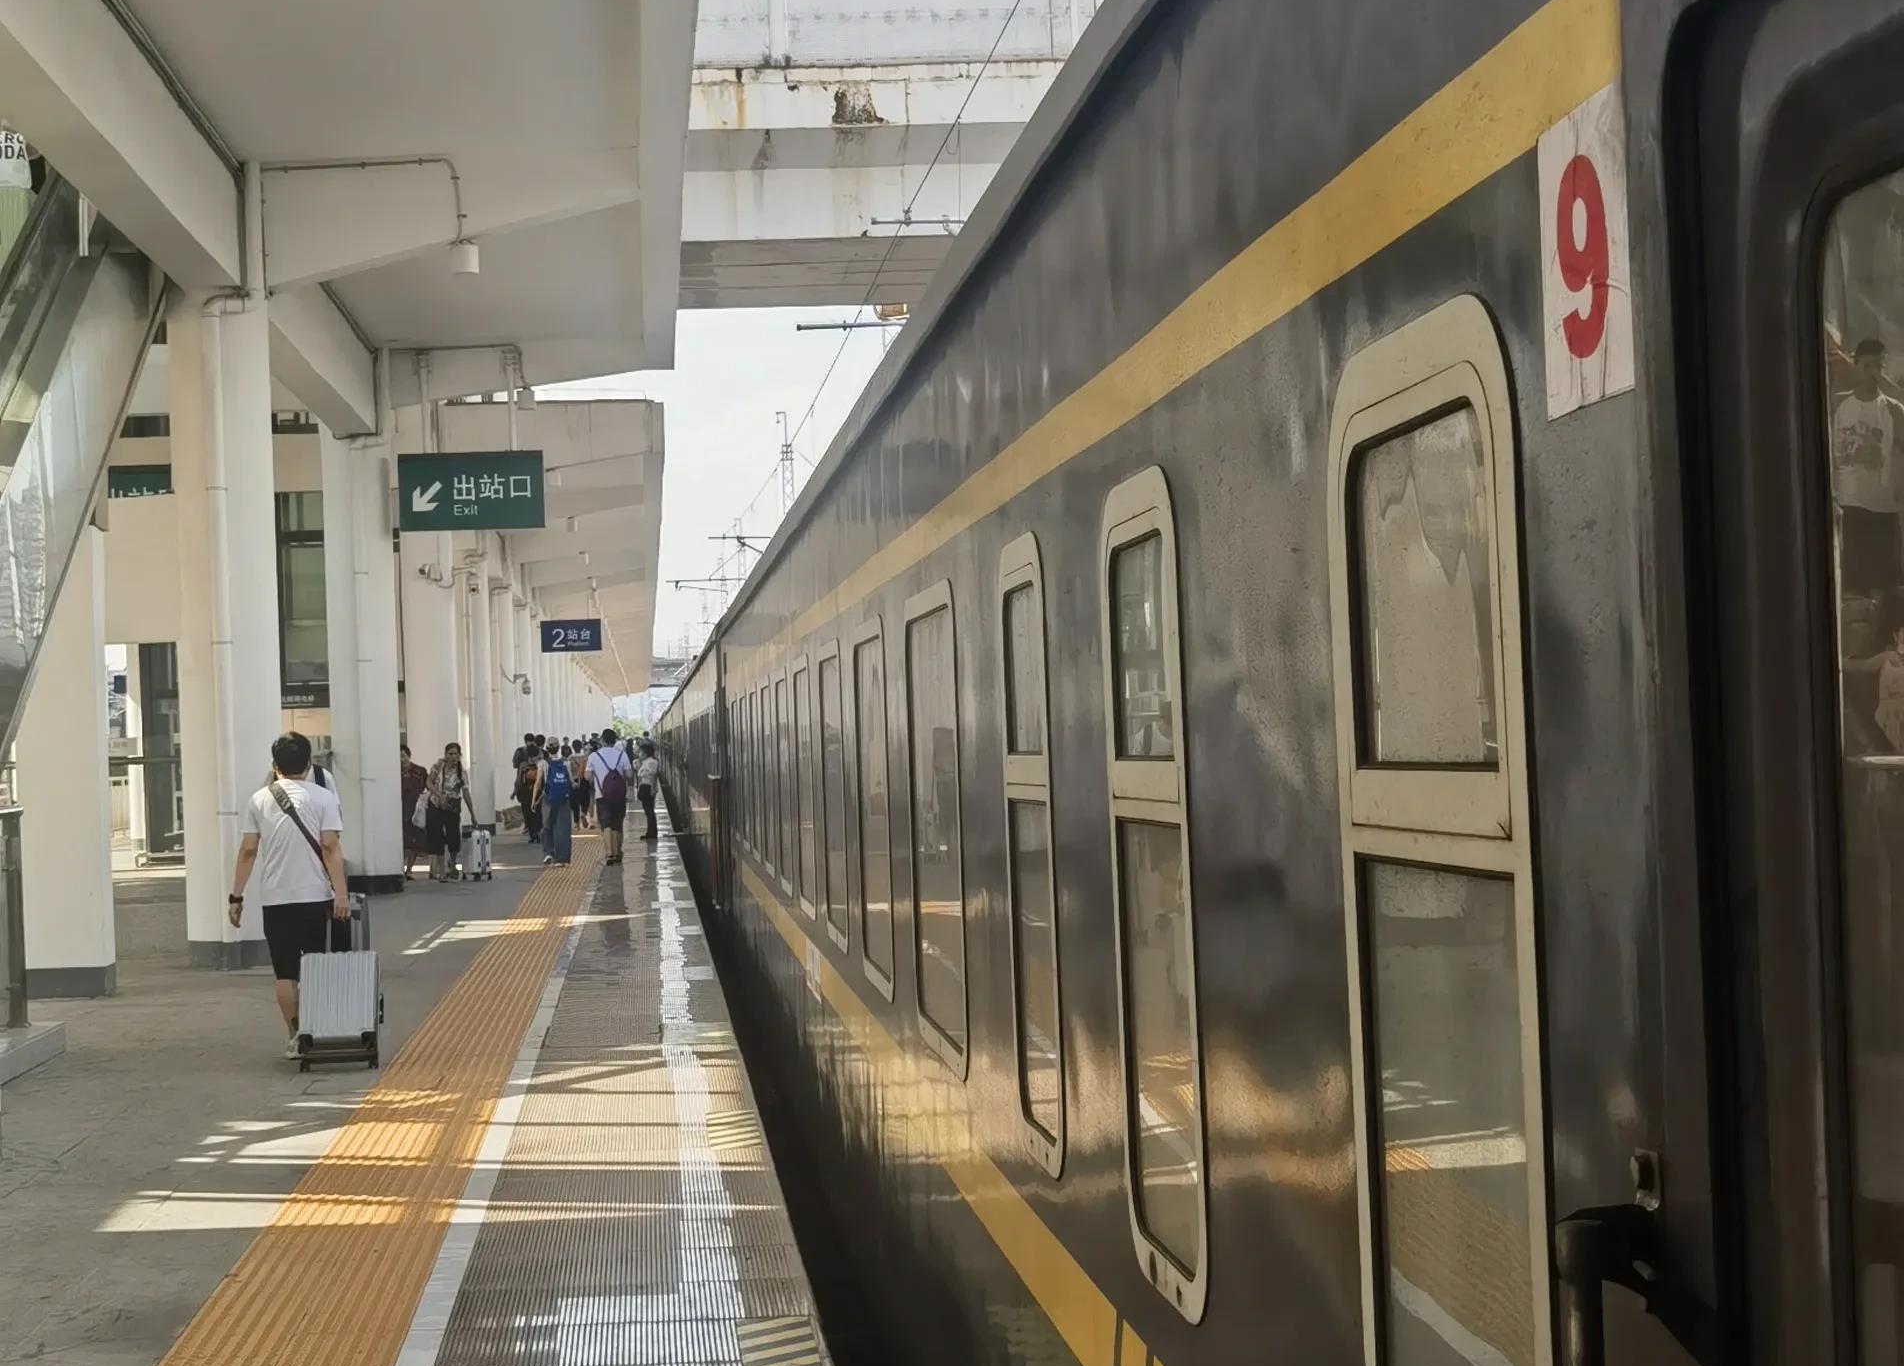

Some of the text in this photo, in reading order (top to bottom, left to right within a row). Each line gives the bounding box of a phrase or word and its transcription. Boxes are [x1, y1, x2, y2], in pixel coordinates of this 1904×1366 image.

[1557, 154, 1609, 359] 9
[453, 473, 532, 501] 出站口
[453, 504, 478, 516] Exit
